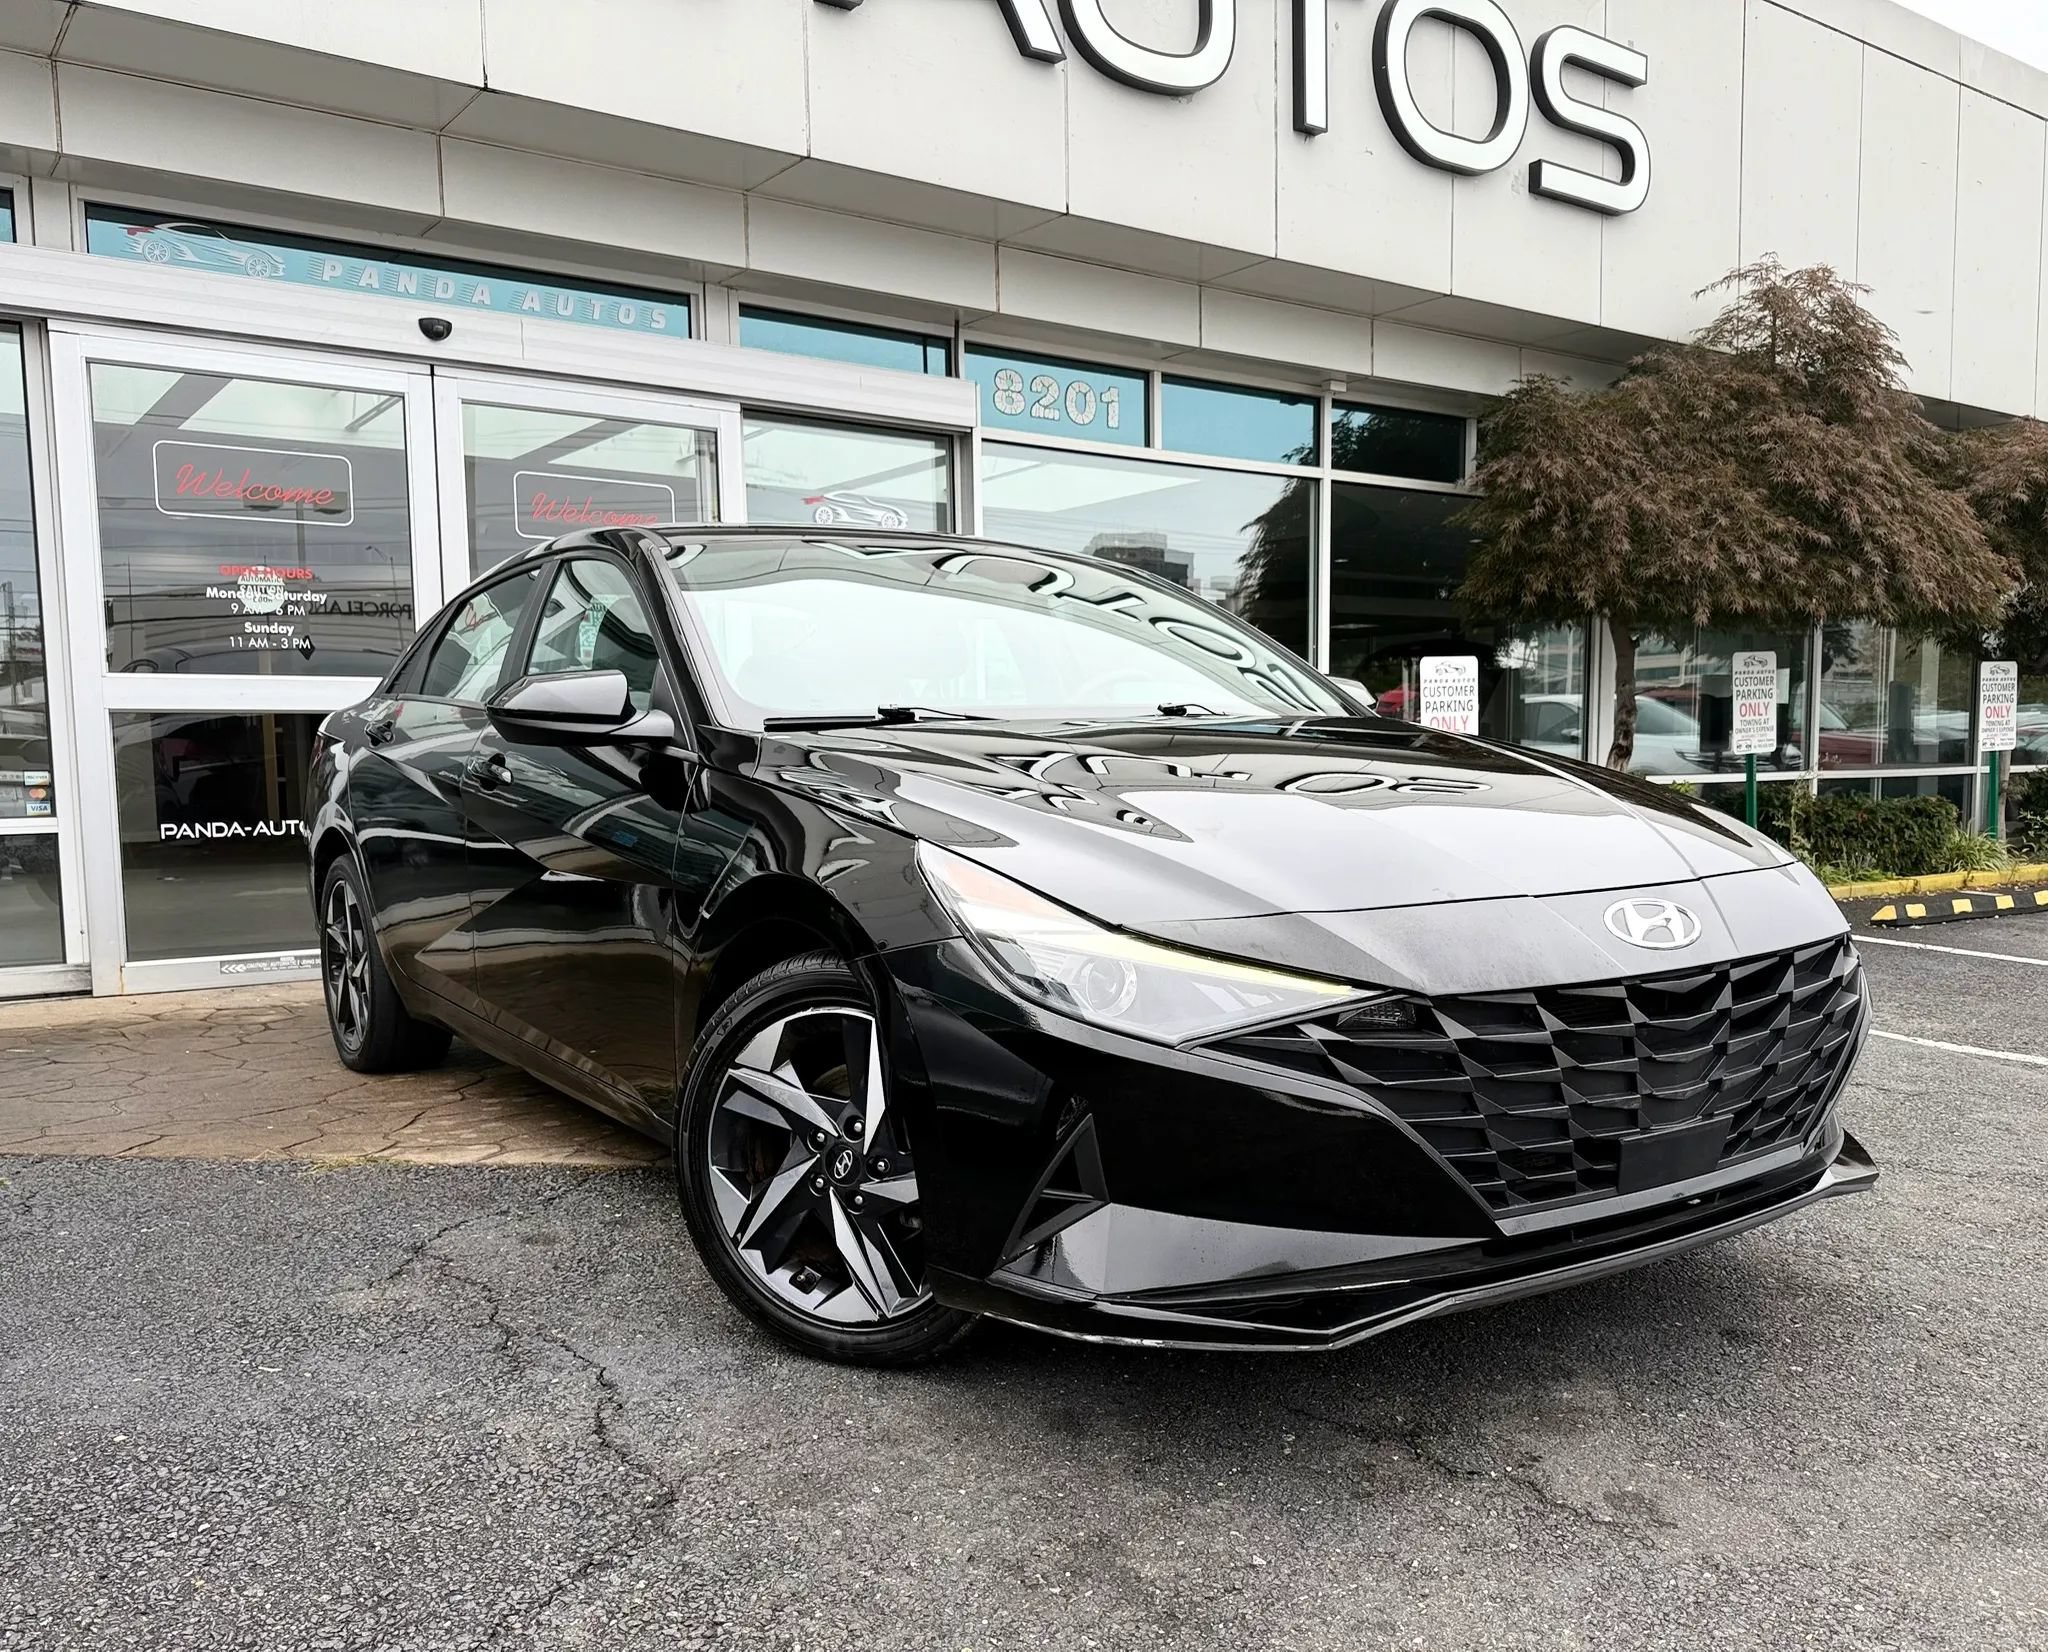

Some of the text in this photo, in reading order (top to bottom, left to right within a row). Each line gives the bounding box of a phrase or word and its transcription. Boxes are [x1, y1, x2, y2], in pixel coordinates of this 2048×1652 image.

[319, 257, 667, 330] PANDA AUTOS
[992, 368, 1120, 430] 8201
[175, 463, 335, 505] Welcome
[230, 603, 240, 614] 9
[275, 605, 284, 616] 6
[287, 604, 306, 617] PM
[244, 622, 295, 636] Sunday
[229, 637, 244, 648] 11
[248, 637, 269, 649] AM
[280, 638, 289, 649] 3
[293, 638, 311, 650] PM
[1734, 676, 1774, 687] CUSTOMER
[1982, 683, 2015, 692] CUSTOMER
[1423, 686, 1475, 697] CUSTOMER
[1735, 688, 1773, 700] PARKING
[1982, 693, 2014, 704] PARKING
[1425, 700, 1473, 712] PARKING
[1739, 702, 1770, 717] ONLY
[1985, 705, 2011, 719] ONLY
[1430, 715, 1469, 731] ONLY
